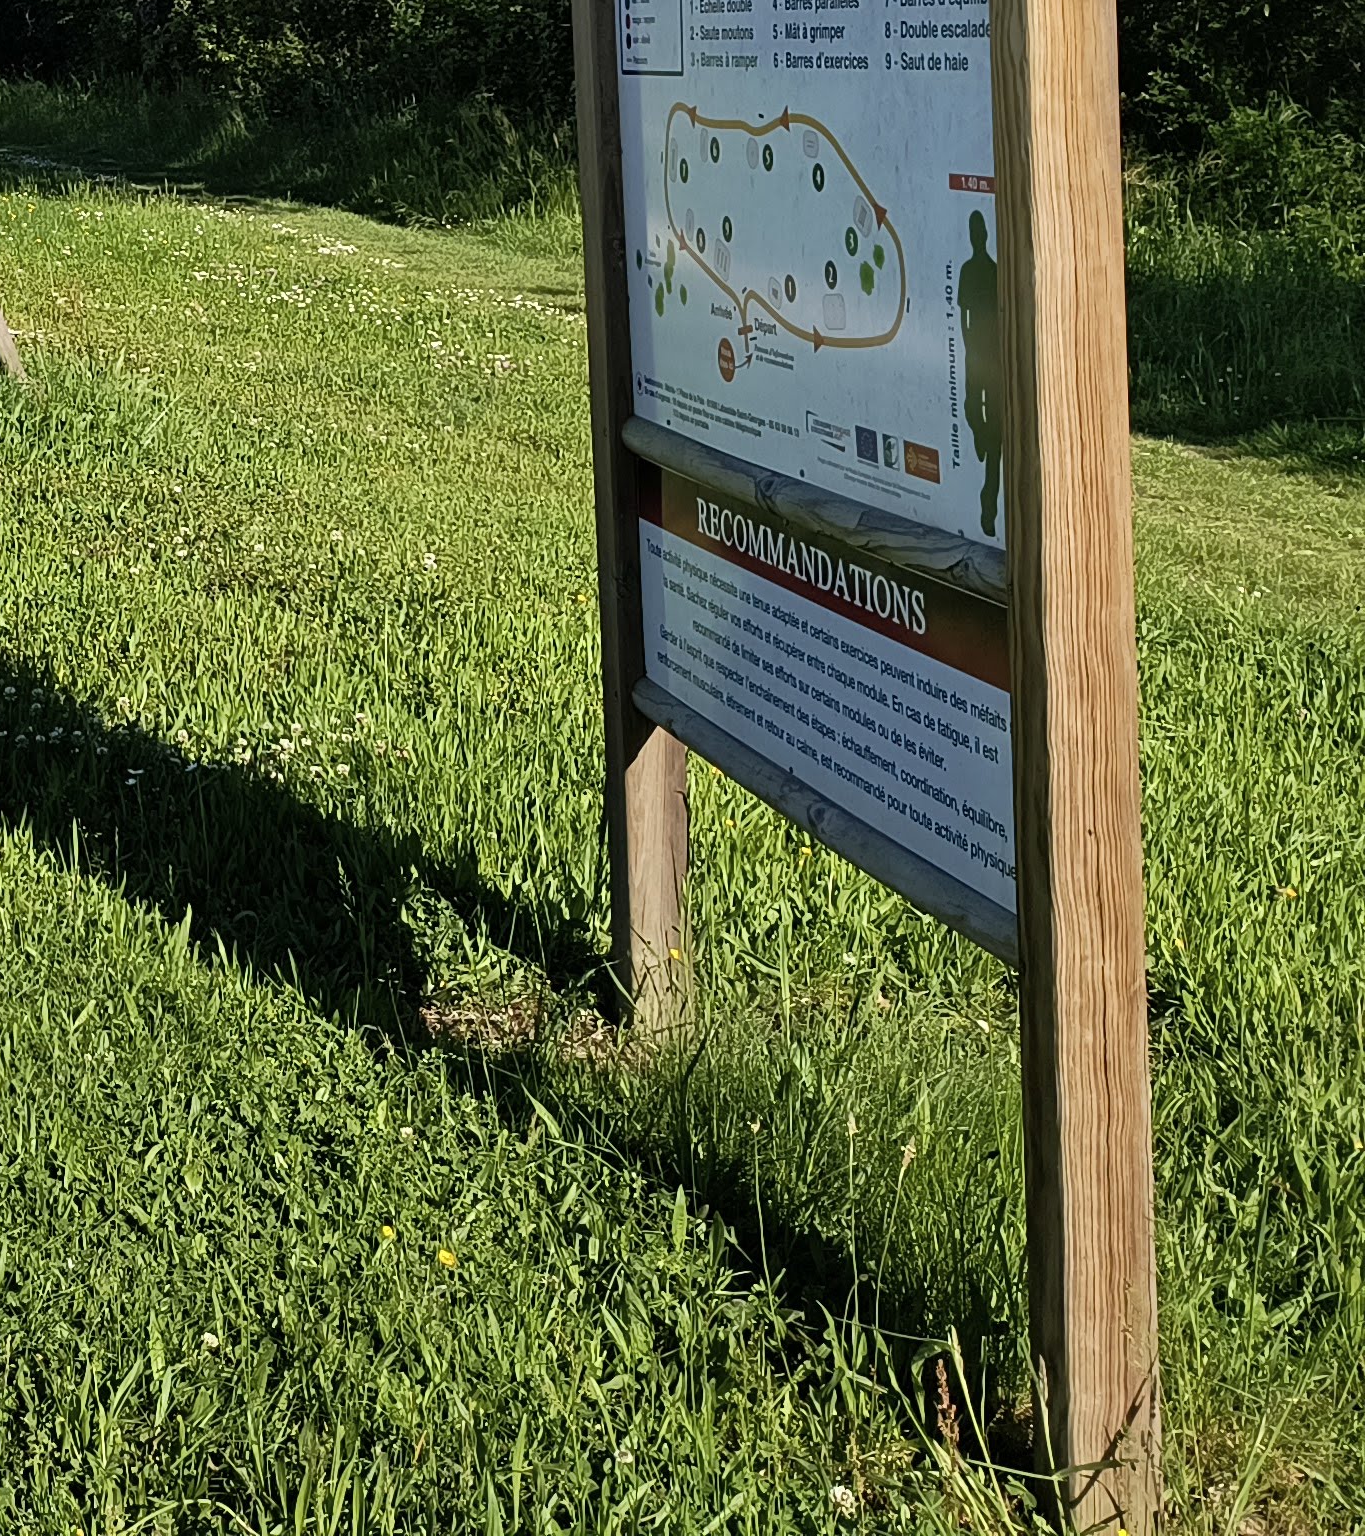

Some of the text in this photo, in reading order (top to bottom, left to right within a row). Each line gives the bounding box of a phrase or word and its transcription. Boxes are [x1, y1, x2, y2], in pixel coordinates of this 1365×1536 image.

[690, 0, 694, 15] 1
[690, 25, 695, 40] 2
[700, 25, 719, 40] Saute
[722, 25, 753, 40] moutons
[772, 24, 778, 39] 5
[803, 22, 808, 39] à
[810, 23, 845, 44] grimper
[884, 21, 891, 39] 8
[900, 19, 938, 39] Double
[691, 52, 696, 67] 3
[701, 52, 723, 67] Barres
[726, 51, 729, 67] à
[732, 55, 758, 72] ramper
[773, 52, 778, 68] 6
[785, 52, 814, 68] Barres
[816, 52, 869, 69] d'exercices
[885, 52, 892, 70] 9
[900, 52, 925, 71] Saut
[928, 52, 941, 71] de
[944, 52, 969, 71] haie
[712, 142, 718, 157] 6
[765, 150, 771, 165] 5
[816, 169, 821, 185] 4
[849, 233, 854, 250] 3
[829, 266, 834, 282] 2
[753, 317, 778, 336] Départ
[948, 337, 958, 419] minimum
[950, 423, 961, 470] Taille
[696, 497, 927, 636] RECOMMANDATIONS
[709, 572, 738, 598] nécessite
[739, 589, 751, 604] une
[752, 593, 770, 614] tenue
[771, 605, 799, 629] adaptée
[801, 619, 808, 634] et
[810, 625, 839, 650] certains
[841, 640, 879, 669] exercices
[880, 660, 915, 688] peuvent
[916, 673, 948, 703] induire
[950, 691, 967, 713] des
[970, 703, 1007, 732] méfaits
[693, 620, 947, 772] recommandé de limiter ses efforts sur certains modules ou de les éviter.
[730, 613, 741, 628] vos
[743, 618, 764, 641] efforts
[765, 629, 771, 645] et
[773, 634, 805, 662] récupérer
[806, 654, 825, 674] entre
[827, 663, 855, 689] chaque
[857, 680, 890, 708] module.
[892, 694, 903, 715] En
[906, 706, 921, 724] cas
[924, 712, 935, 732] de
[938, 718, 972, 754] fatigue,
[974, 736, 980, 754] il
[982, 744, 999, 764] est
[703, 654, 714, 670] que
[716, 661, 745, 687] respecter
[796, 705, 810, 726] des
[811, 714, 836, 742] étapes
[841, 731, 899, 781] échauffement,
[900, 769, 960, 816] coordination,
[962, 799, 1008, 843] équilibre,
[756, 714, 763, 728] et
[764, 719, 785, 740] retour
[786, 732, 795, 747] au
[796, 738, 819, 765] calme,
[821, 754, 833, 771] est
[834, 761, 885, 803] recommandé
[887, 793, 908, 815] pour
[909, 803, 933, 831] toute
[934, 821, 968, 852] activité
[970, 841, 1016, 879] physique
